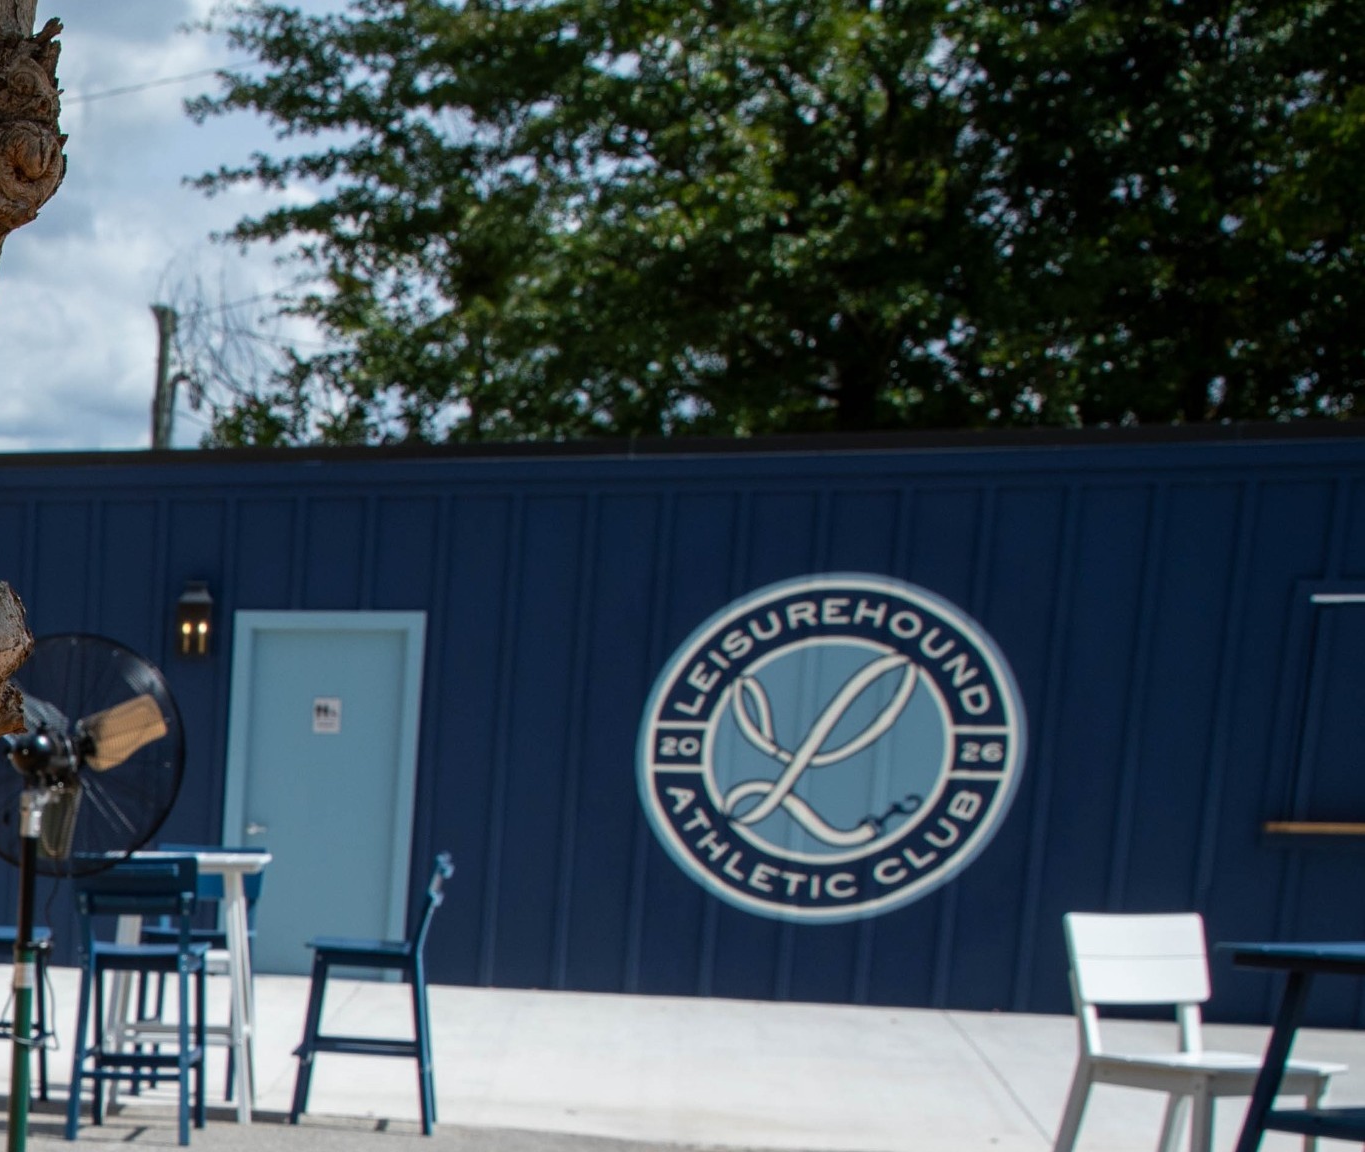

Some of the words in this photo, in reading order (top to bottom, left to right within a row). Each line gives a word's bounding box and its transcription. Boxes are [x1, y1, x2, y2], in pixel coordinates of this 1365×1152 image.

[674, 598, 991, 716] LEISUREHOUND
[659, 736, 700, 756] 20
[960, 742, 1003, 762] 26
[666, 784, 858, 899] ATHLETIC
[874, 789, 982, 885] CLUB
